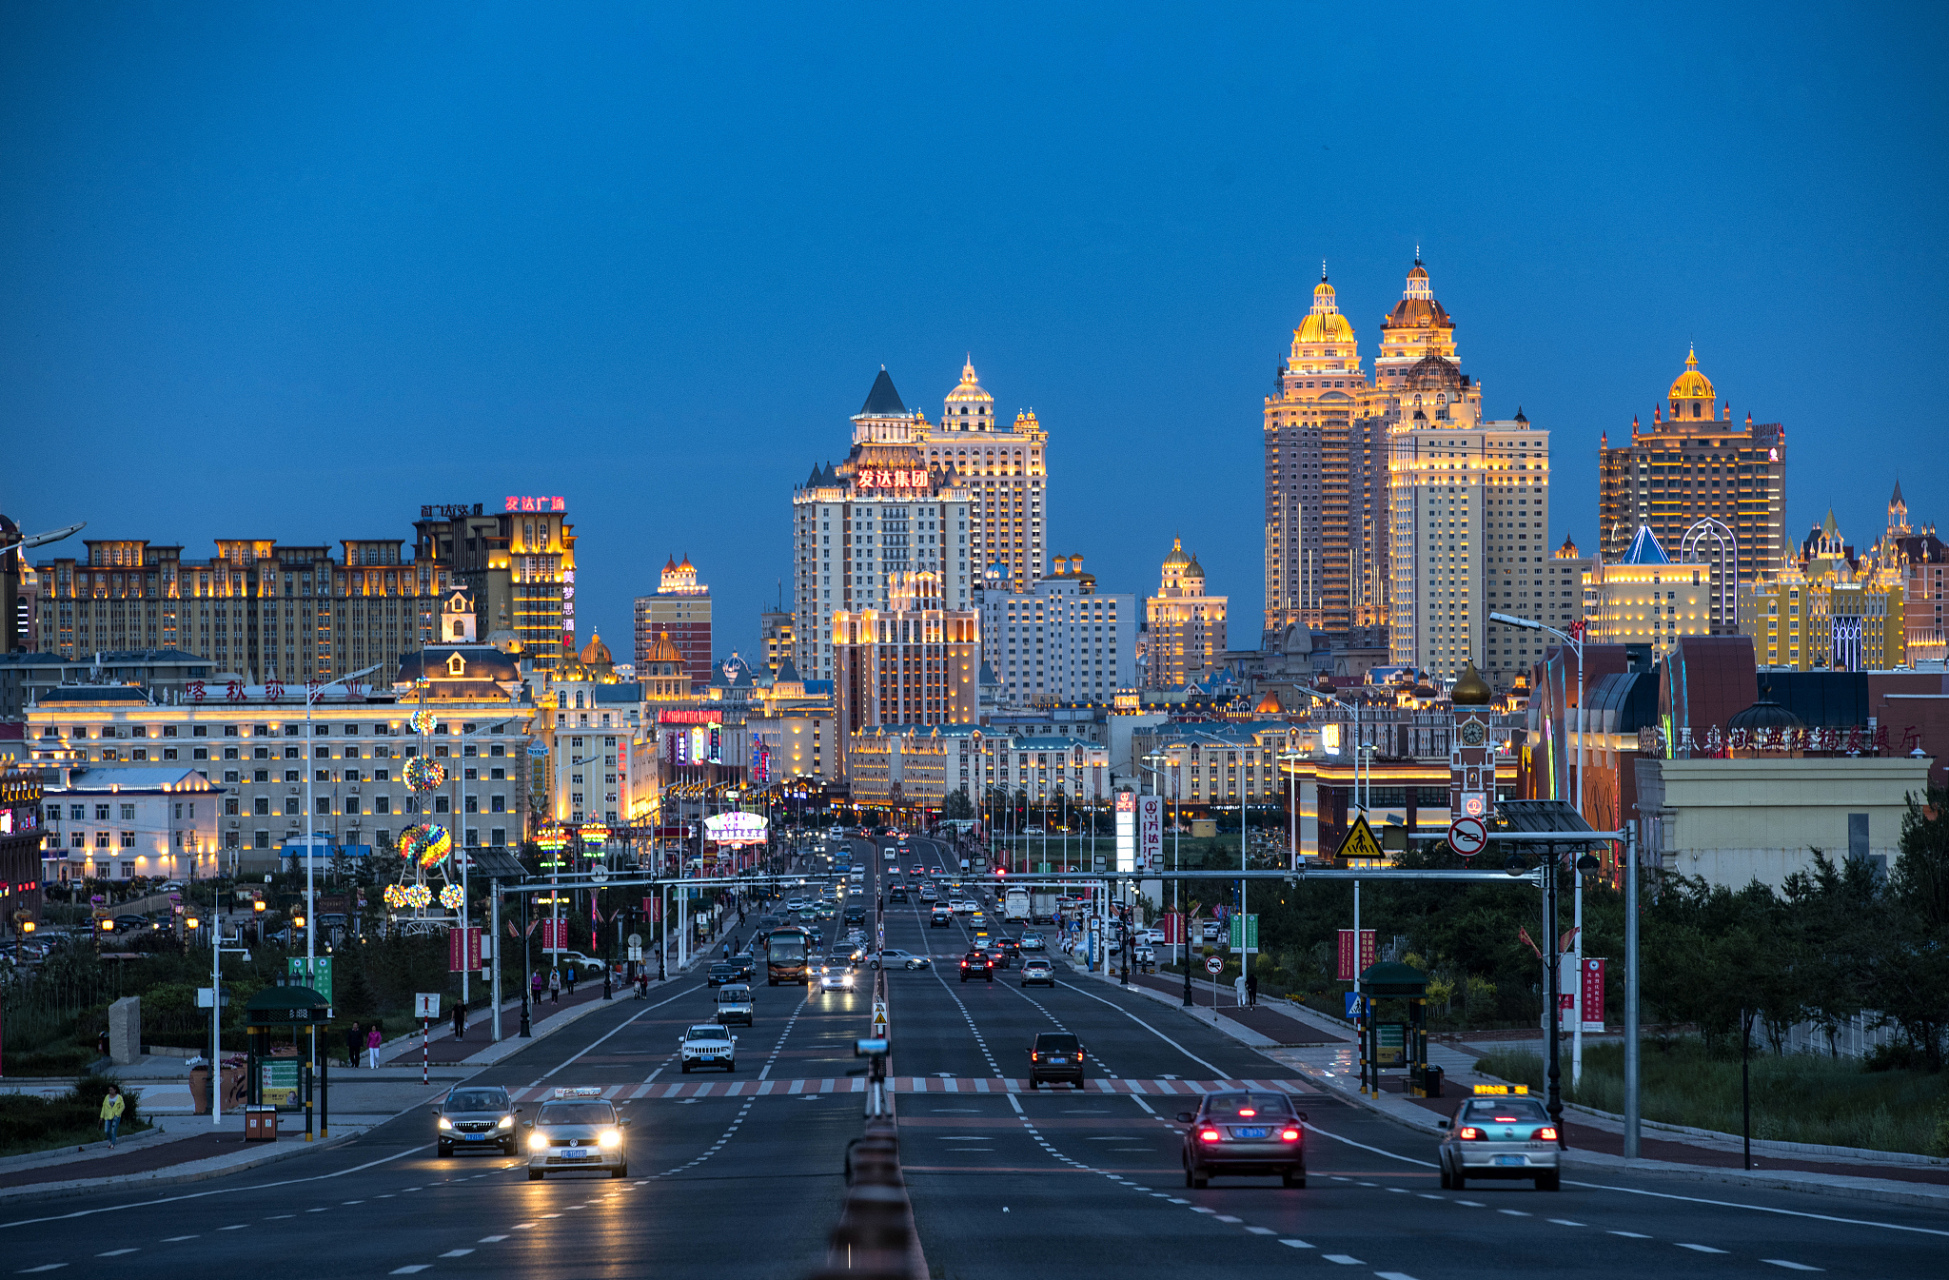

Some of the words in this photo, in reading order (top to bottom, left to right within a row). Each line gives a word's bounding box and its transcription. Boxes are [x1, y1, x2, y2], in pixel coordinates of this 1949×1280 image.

[858, 470, 928, 488] 发达集团
[505, 496, 565, 511] 发达广场
[186, 679, 363, 702] 喀秋莎实业
[1093, 920, 1098, 928] P
